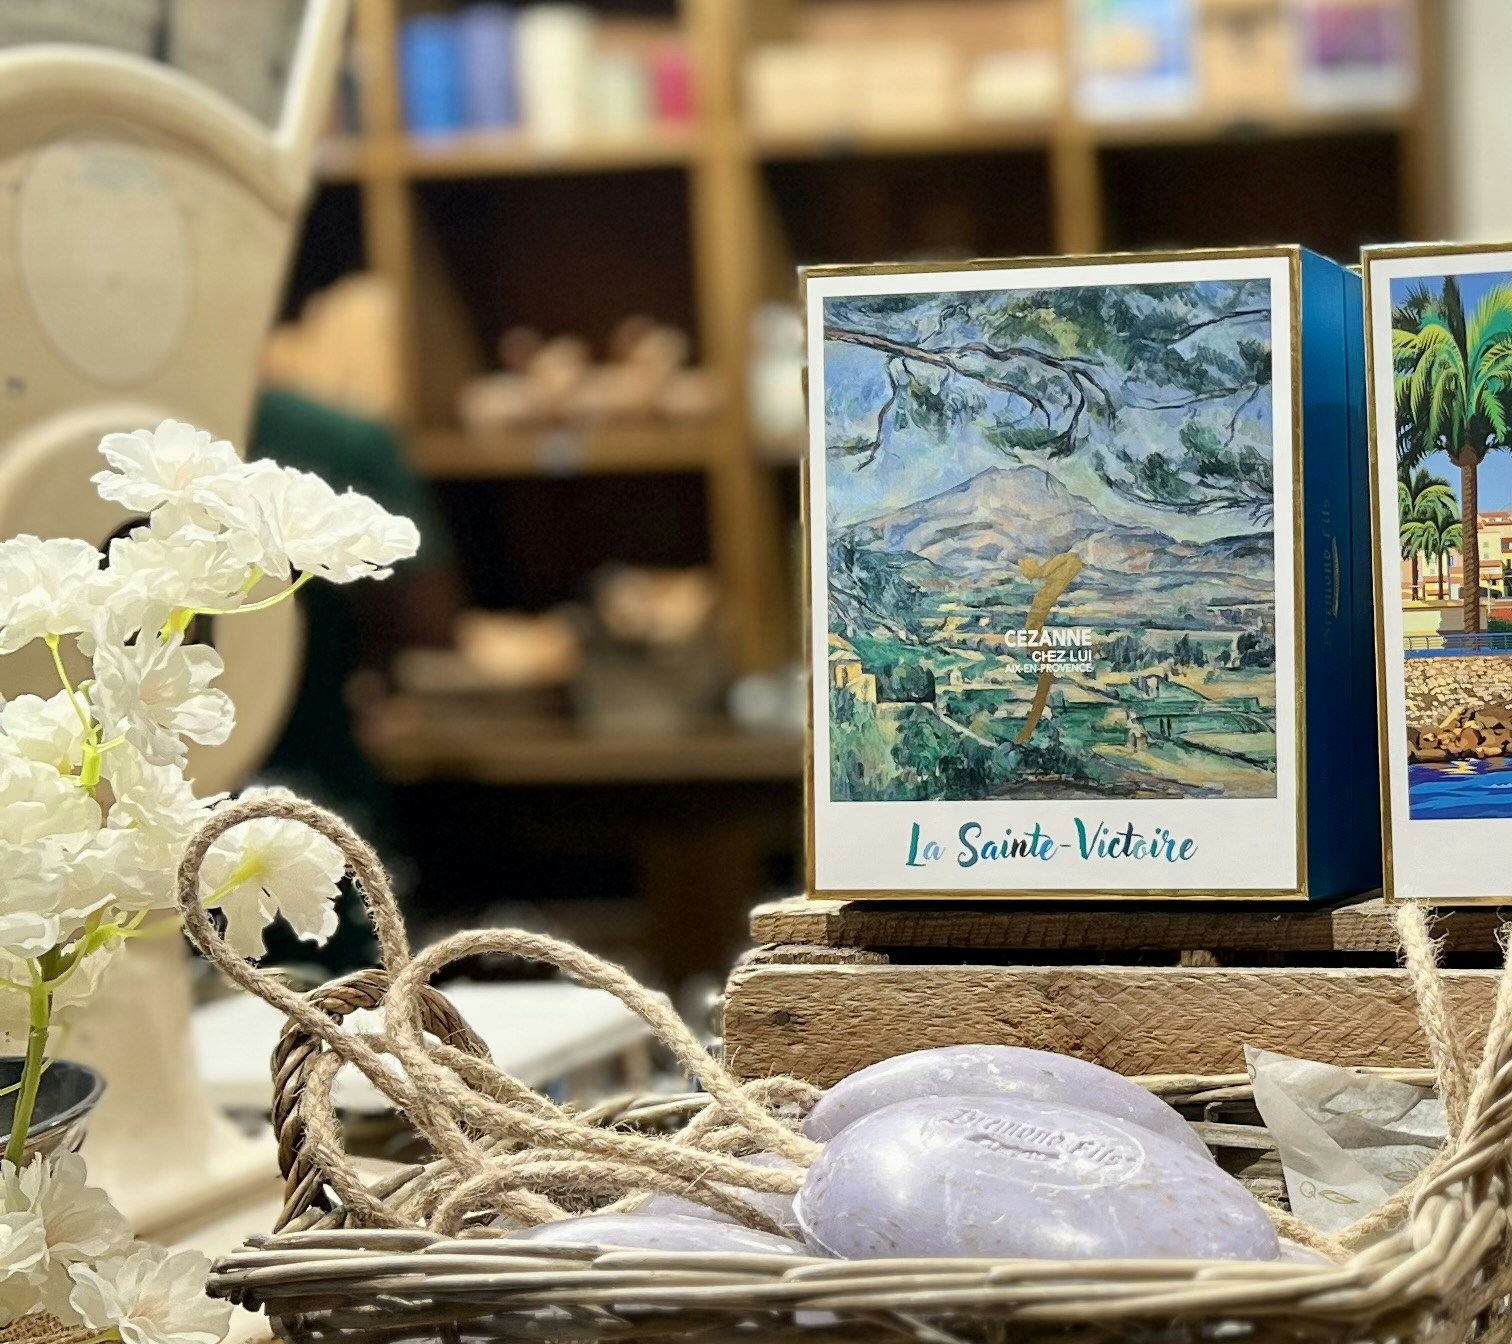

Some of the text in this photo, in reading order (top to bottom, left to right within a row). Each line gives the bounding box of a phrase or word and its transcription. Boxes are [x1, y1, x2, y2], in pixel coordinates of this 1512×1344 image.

[1004, 629, 1093, 648] CEZANNE
[1031, 650, 1093, 663] CHEZ LUI
[1004, 663, 1095, 674] AIX-EN-PROVENCE
[905, 817, 1199, 868] La Sainte-Victoire
